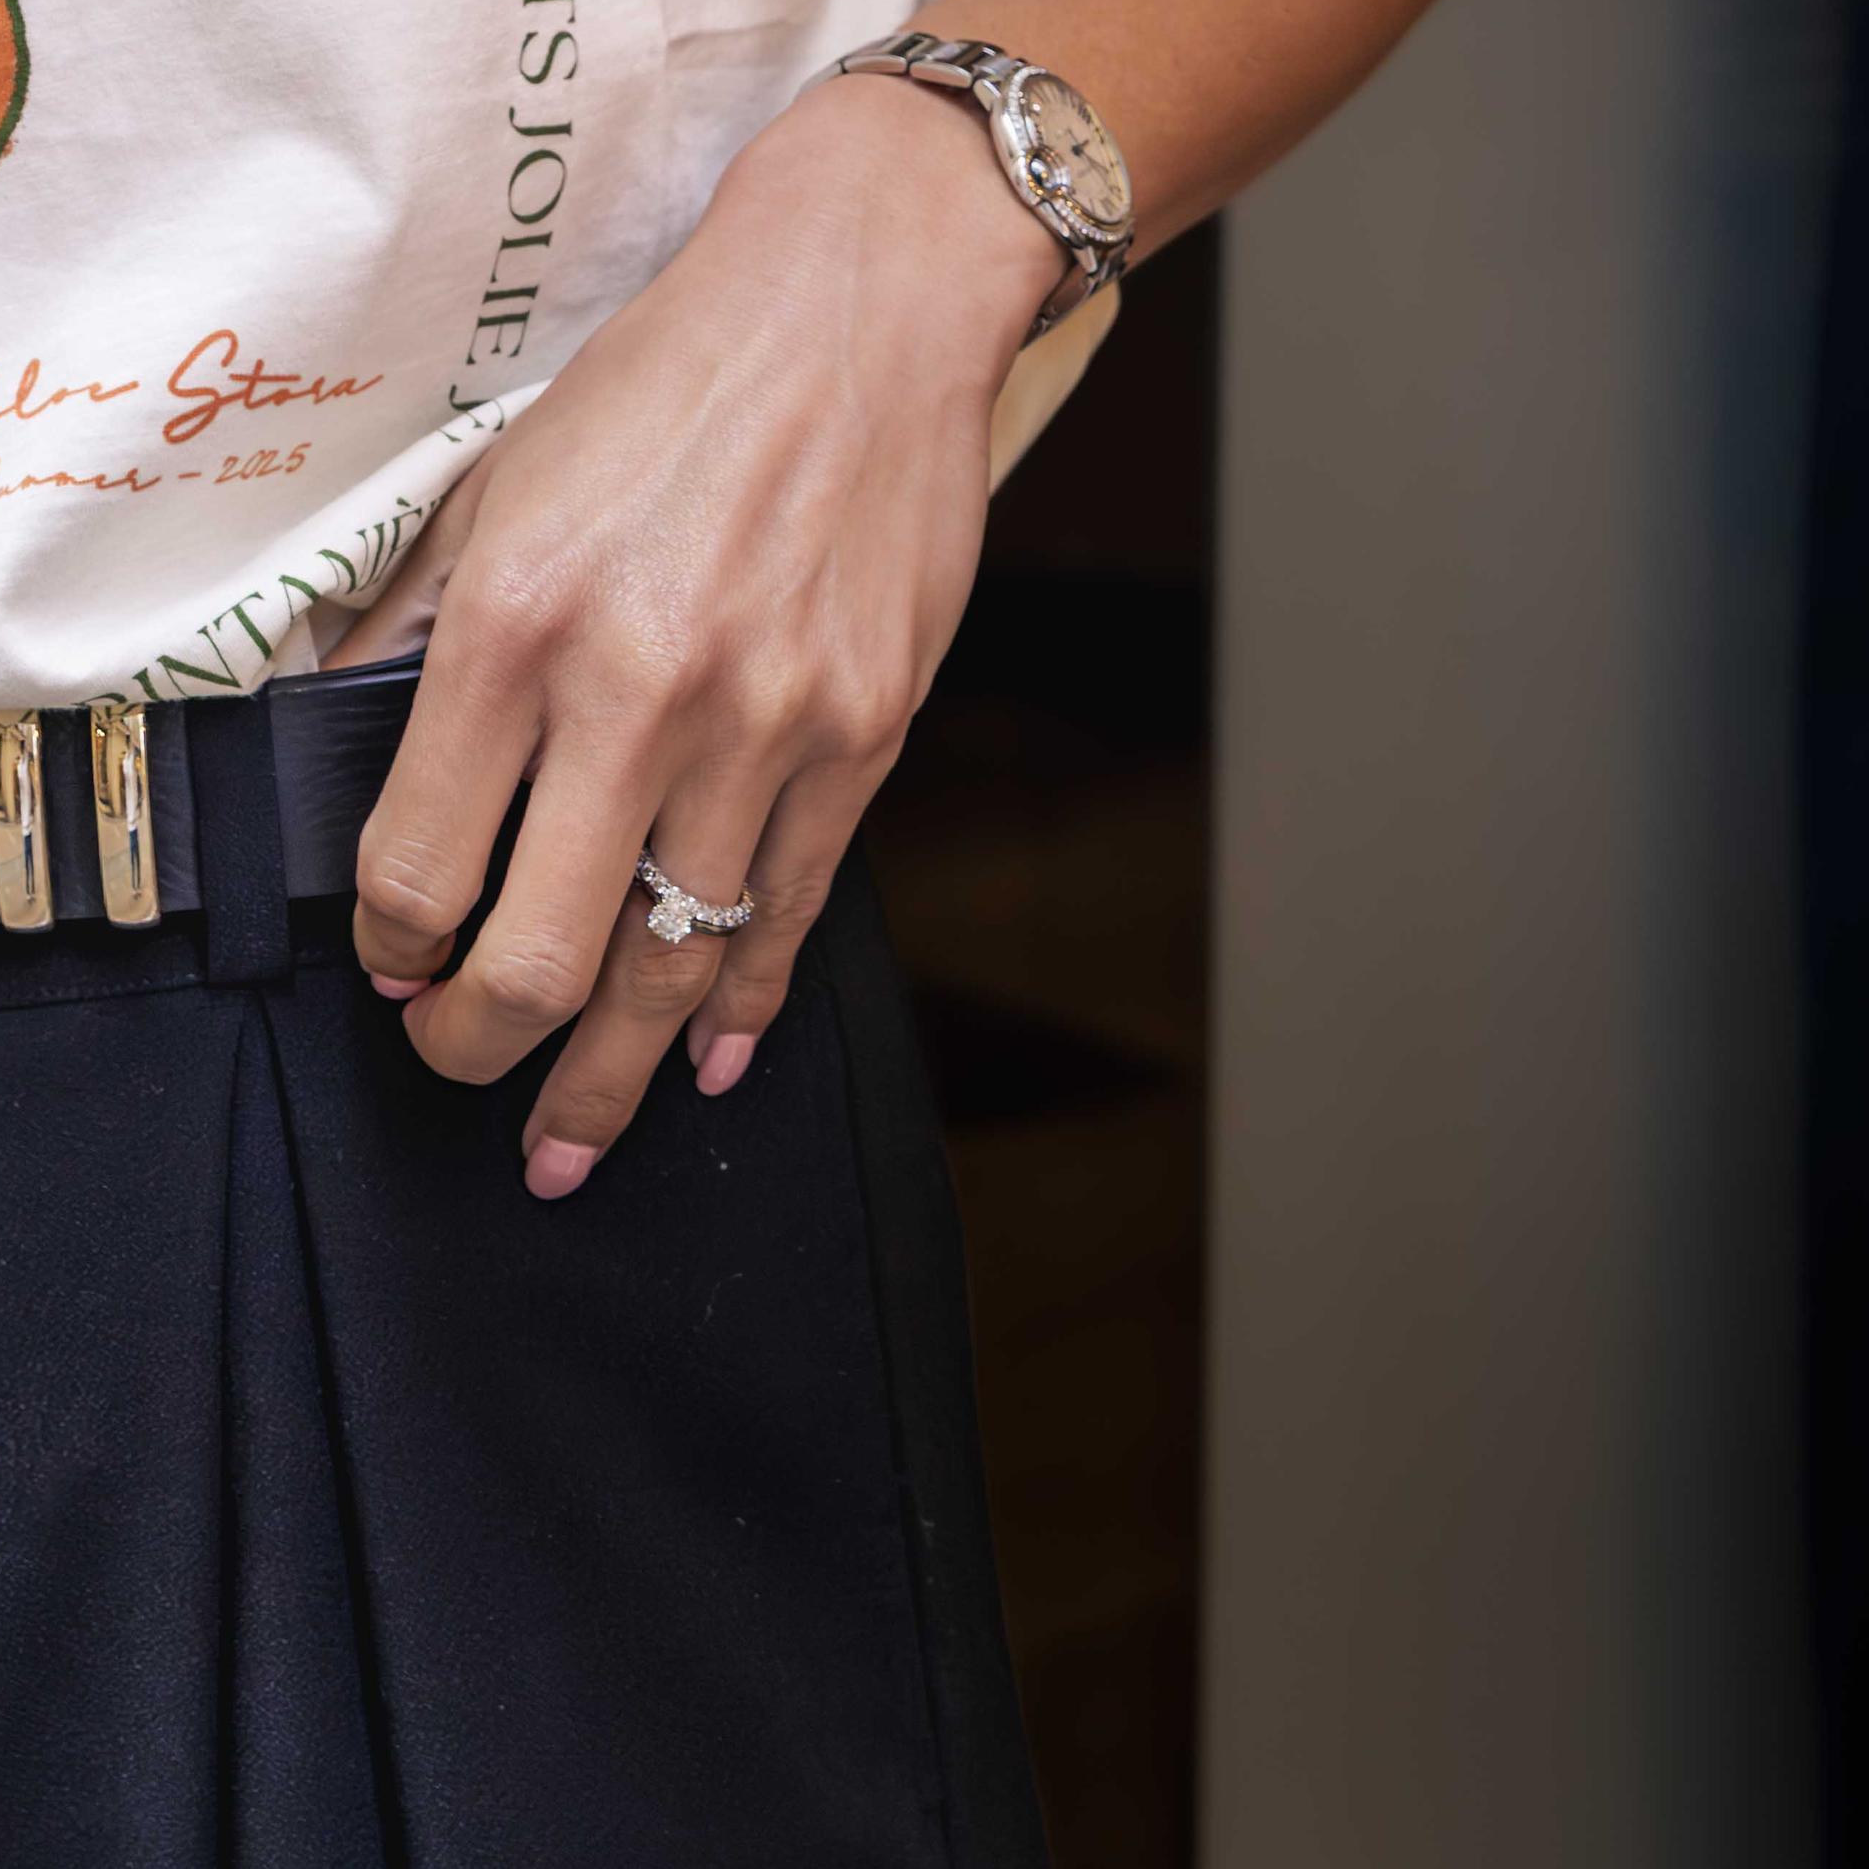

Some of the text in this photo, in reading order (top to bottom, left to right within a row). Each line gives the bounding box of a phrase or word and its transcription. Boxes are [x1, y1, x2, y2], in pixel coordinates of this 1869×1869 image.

[466, 105, 572, 366] JOLIE
[162, 328, 384, 445] Stora
[213, 442, 313, 484] 2025
